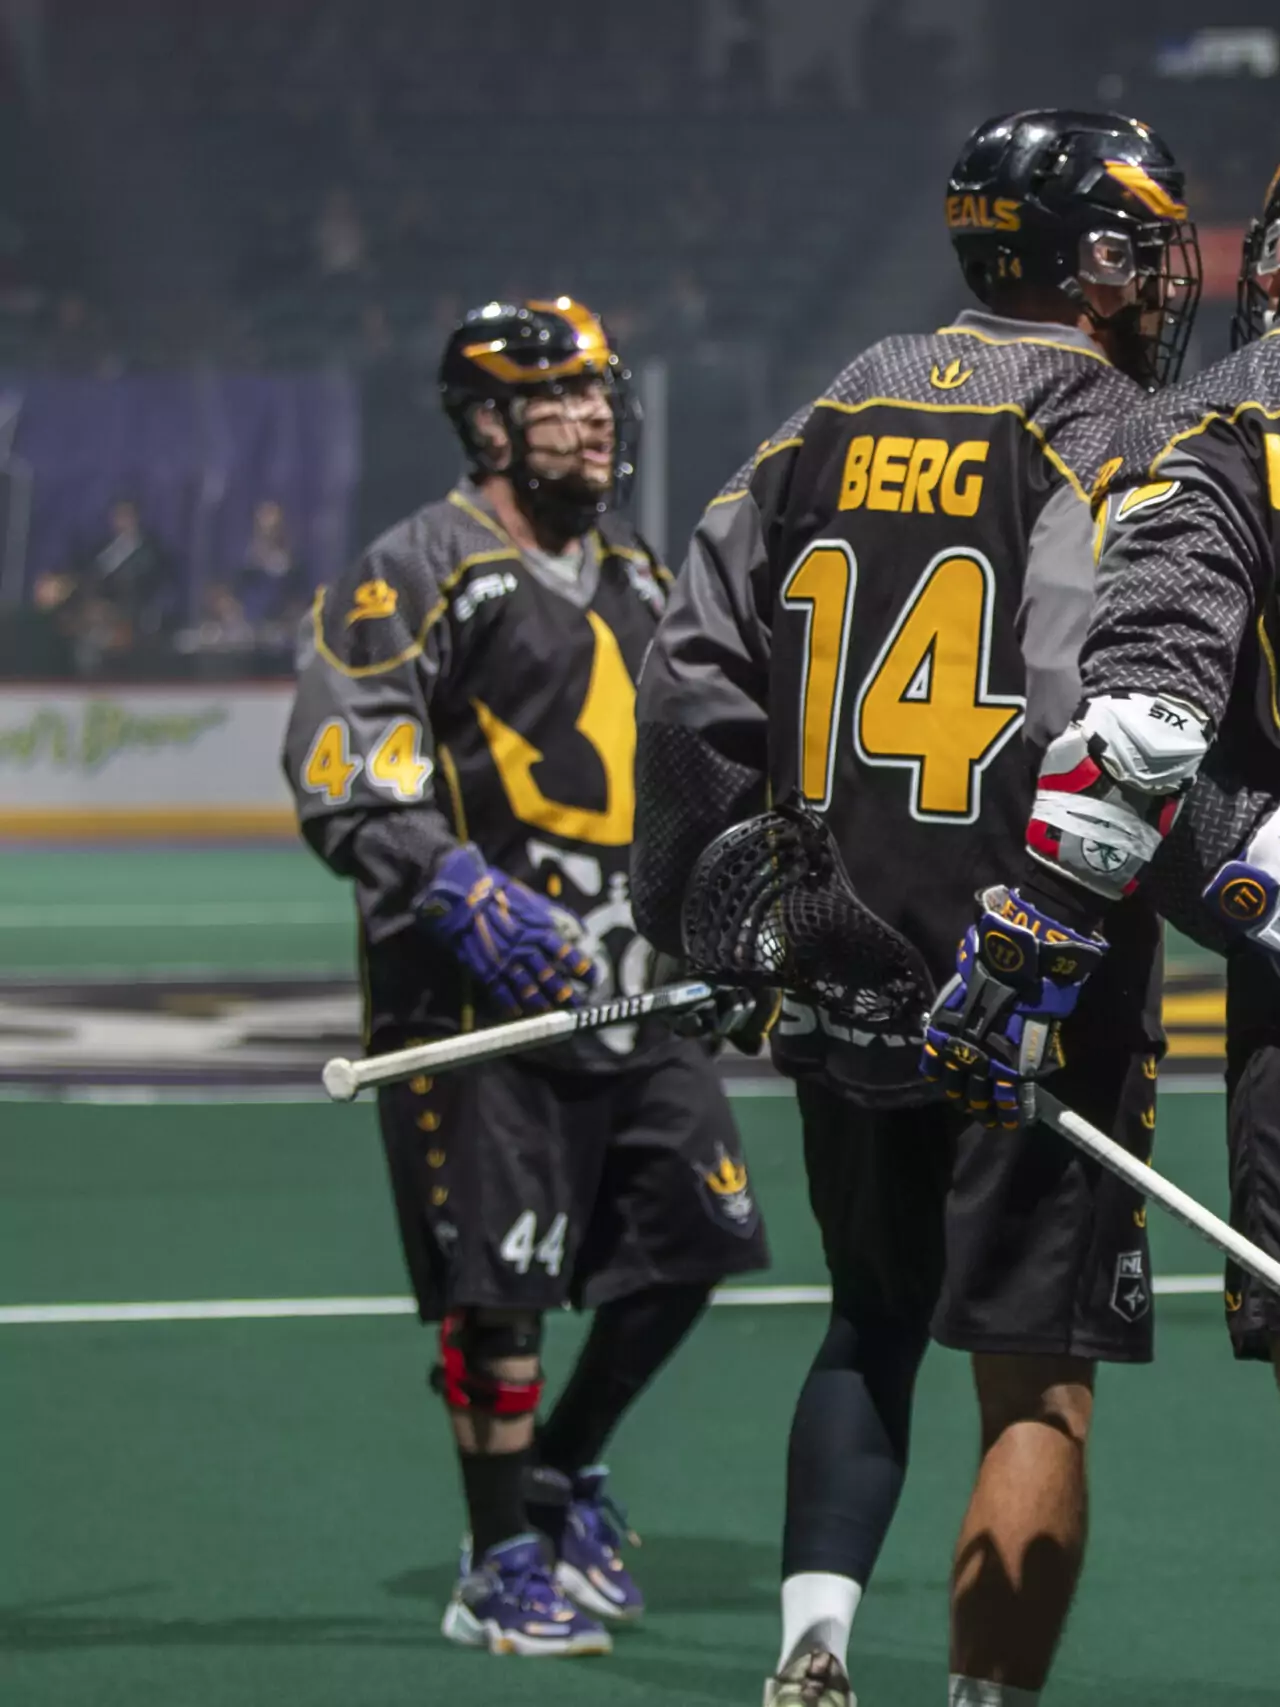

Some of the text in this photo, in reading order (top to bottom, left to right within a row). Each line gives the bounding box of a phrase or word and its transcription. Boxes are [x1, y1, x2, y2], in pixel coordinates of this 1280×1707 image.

[837, 434, 990, 517] BERG
[780, 539, 1027, 826] 14
[1148, 706, 1189, 731] STX
[301, 716, 433, 806] 44
[501, 1208, 568, 1277] 44
